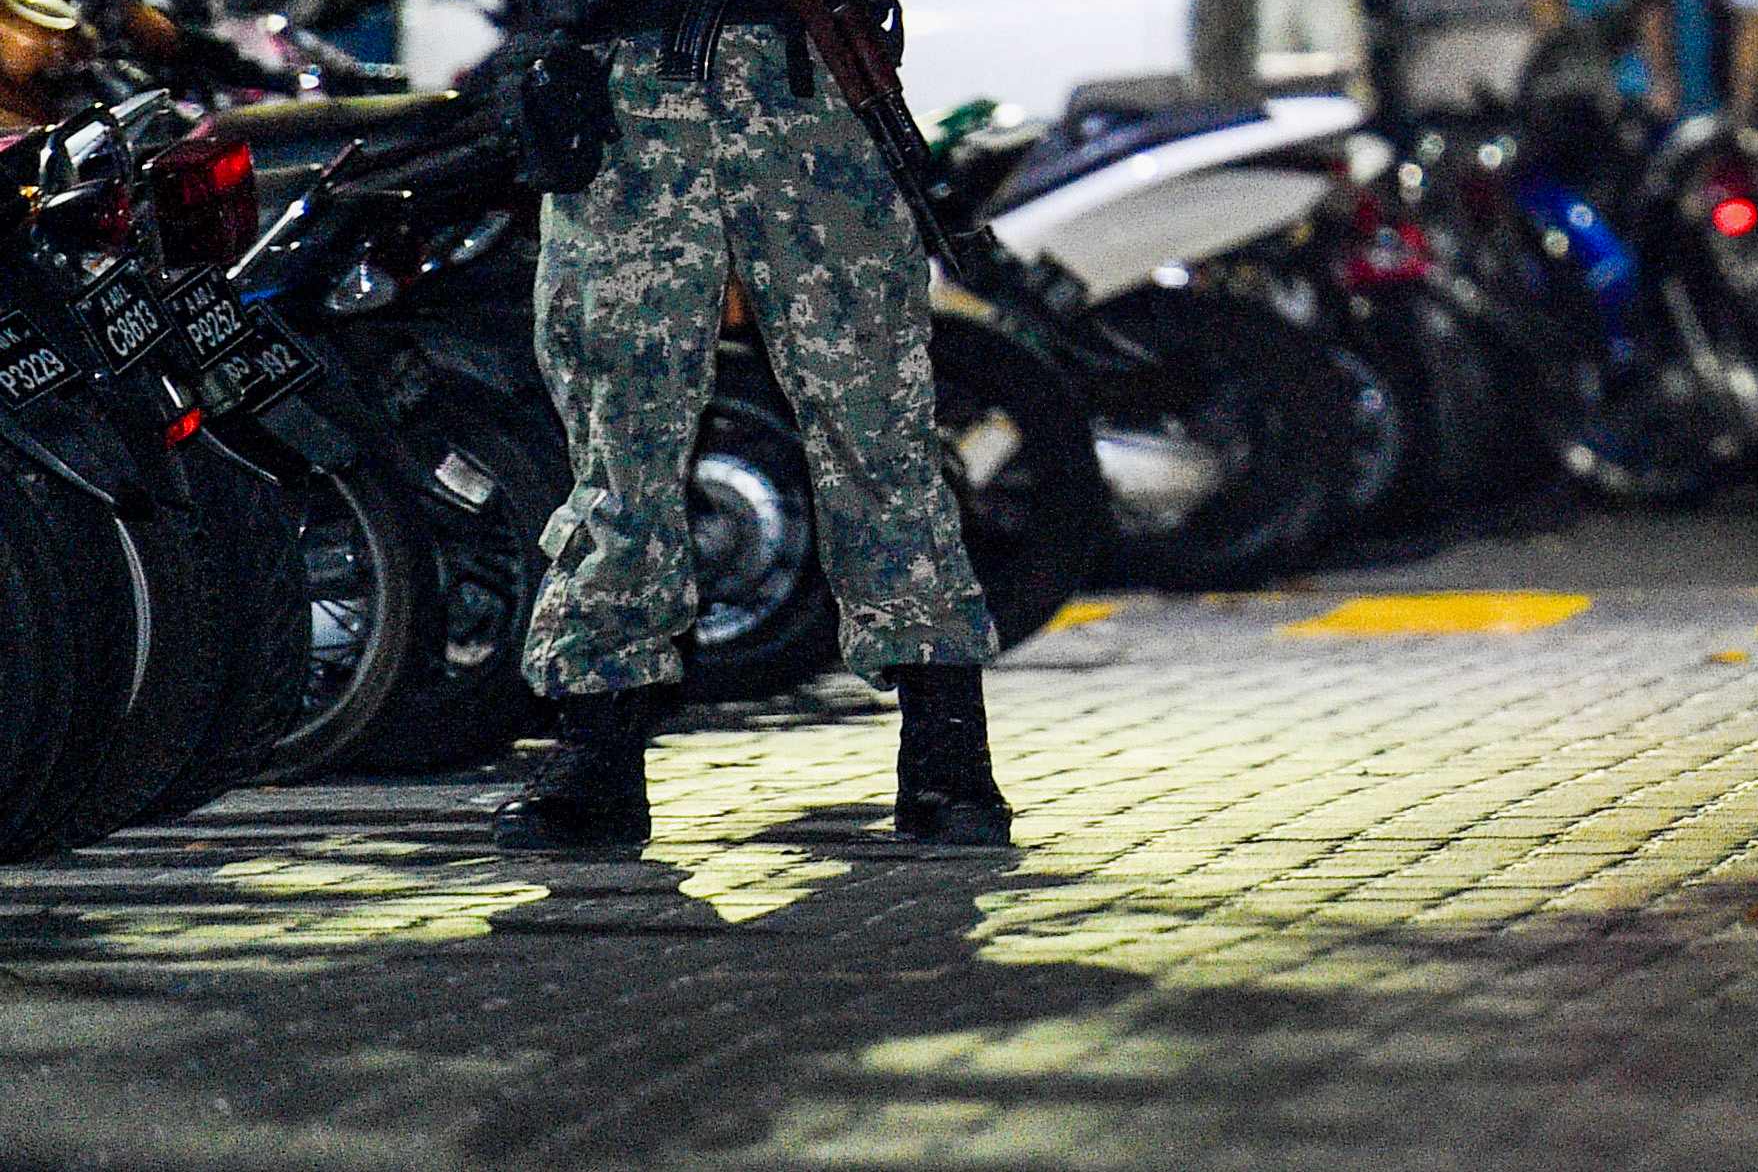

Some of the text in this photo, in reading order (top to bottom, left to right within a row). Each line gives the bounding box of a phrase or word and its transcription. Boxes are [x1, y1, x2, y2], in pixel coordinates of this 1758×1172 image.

[106, 299, 159, 357] C8613
[187, 299, 241, 355] P9252
[0, 348, 65, 398] P3229
